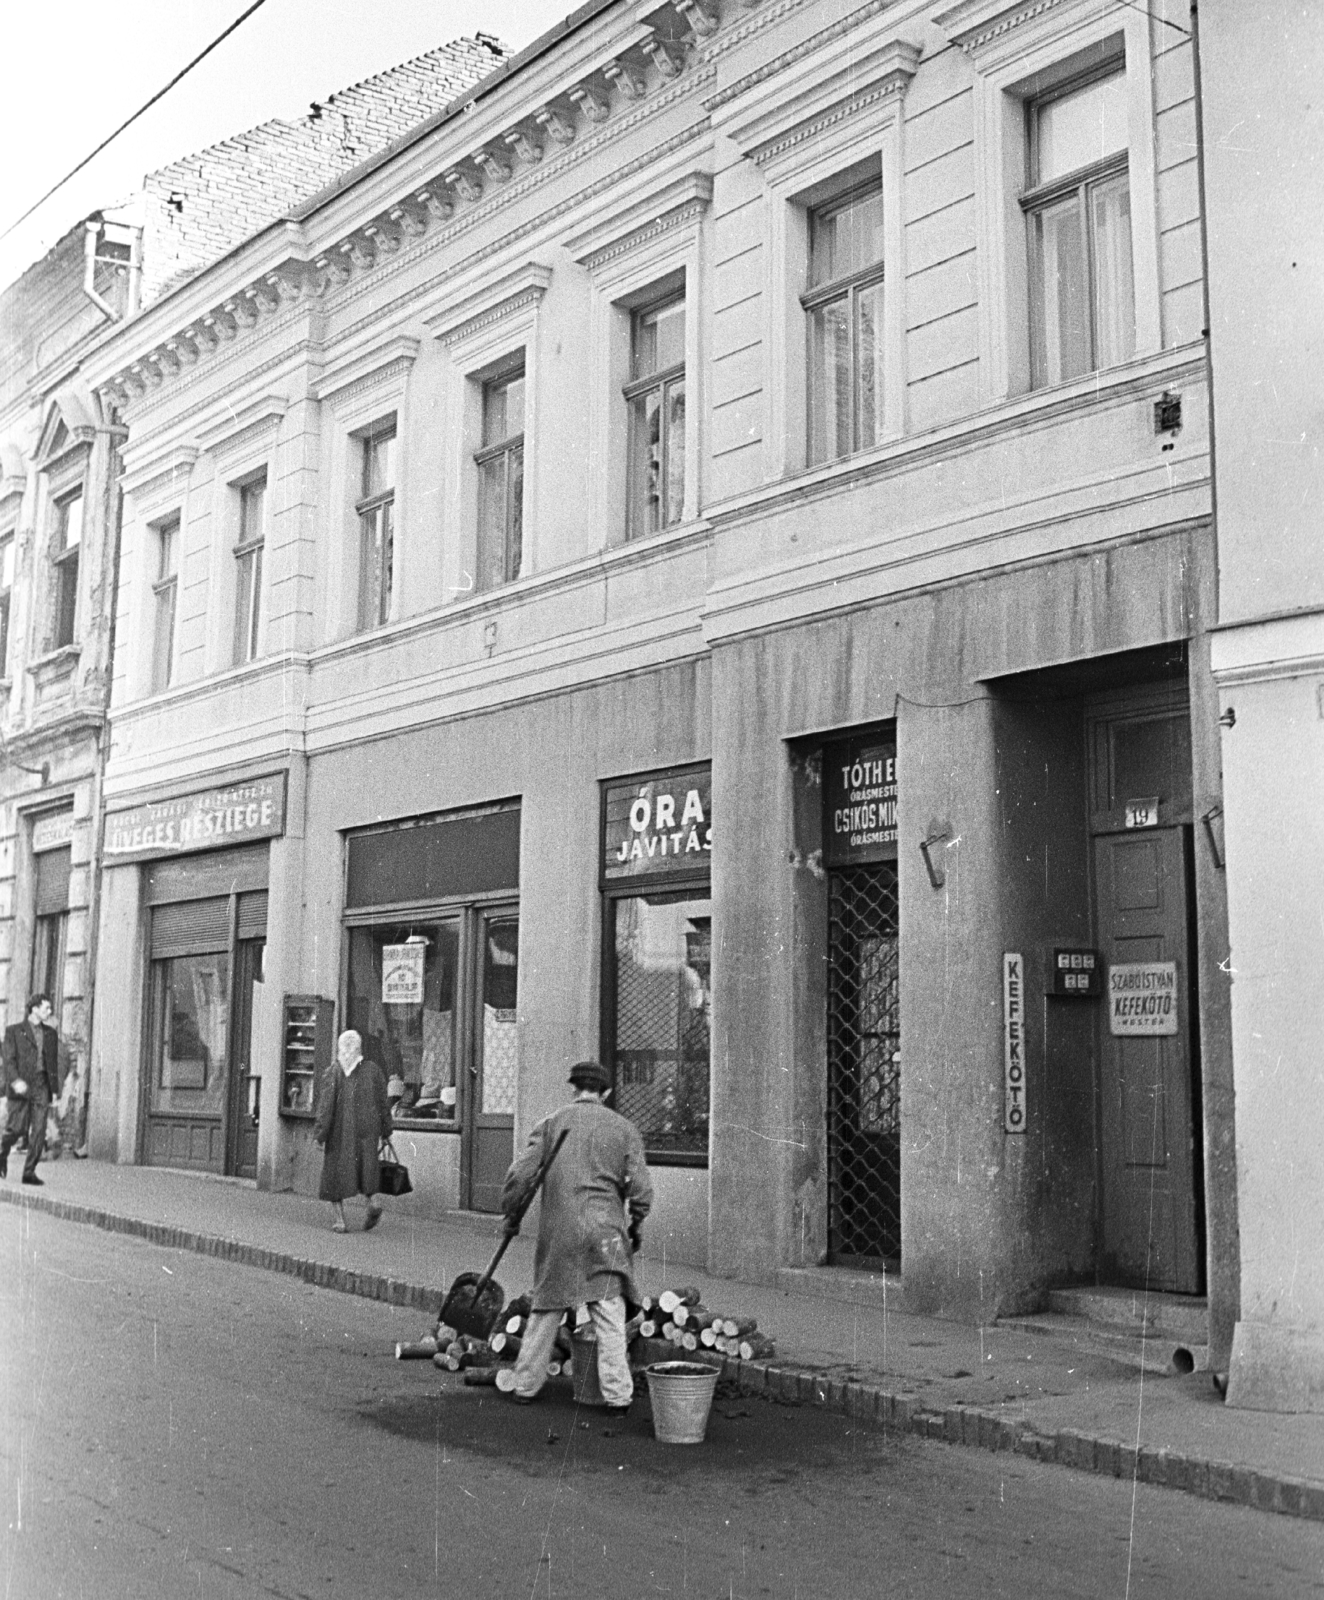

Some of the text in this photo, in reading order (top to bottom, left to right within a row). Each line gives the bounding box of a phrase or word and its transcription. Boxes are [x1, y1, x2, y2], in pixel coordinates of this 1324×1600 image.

[842, 758, 882, 789] TÓTH
[630, 787, 704, 832] ÓRA
[835, 801, 876, 833] CSIKÓS
[1132, 809, 1149, 825] 19
